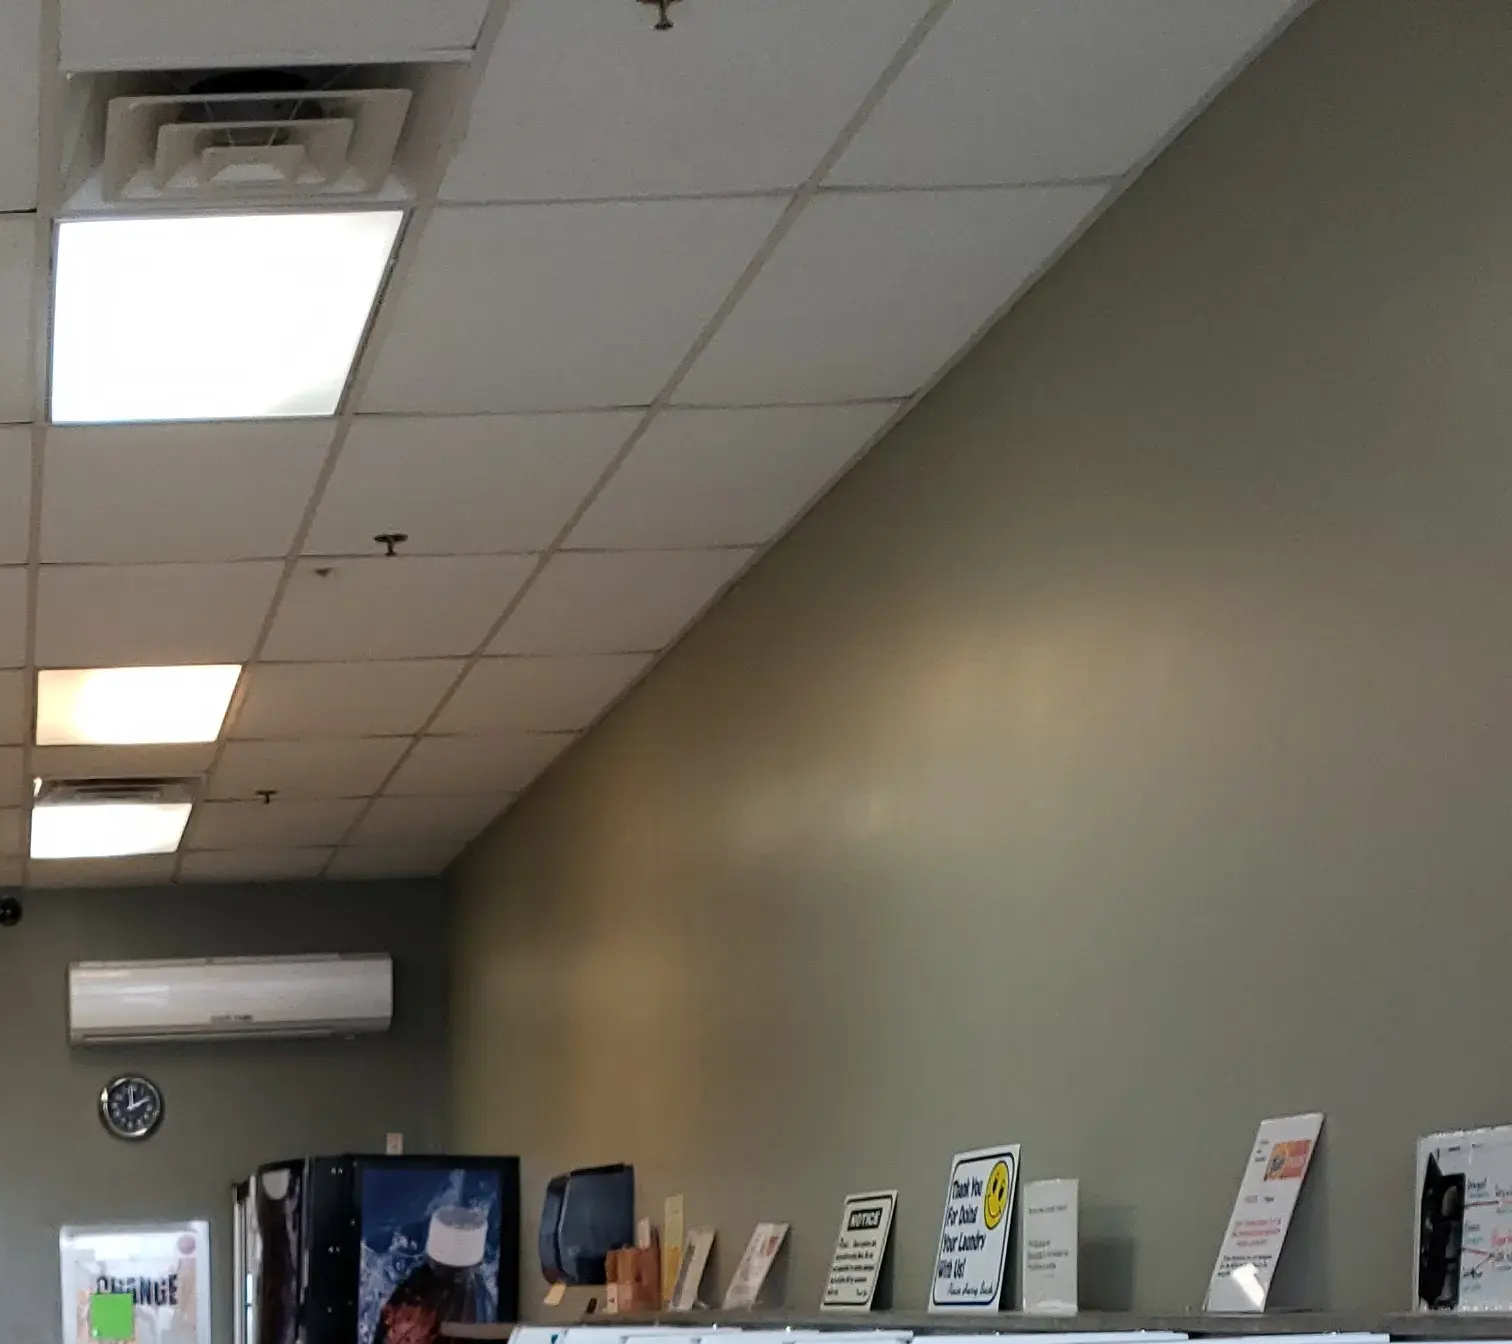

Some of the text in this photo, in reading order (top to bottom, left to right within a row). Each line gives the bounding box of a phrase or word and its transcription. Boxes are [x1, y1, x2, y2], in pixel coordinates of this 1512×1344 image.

[971, 1175, 983, 1197] You
[850, 1210, 880, 1228] NOTICE
[96, 1273, 178, 1306] CHANGE
